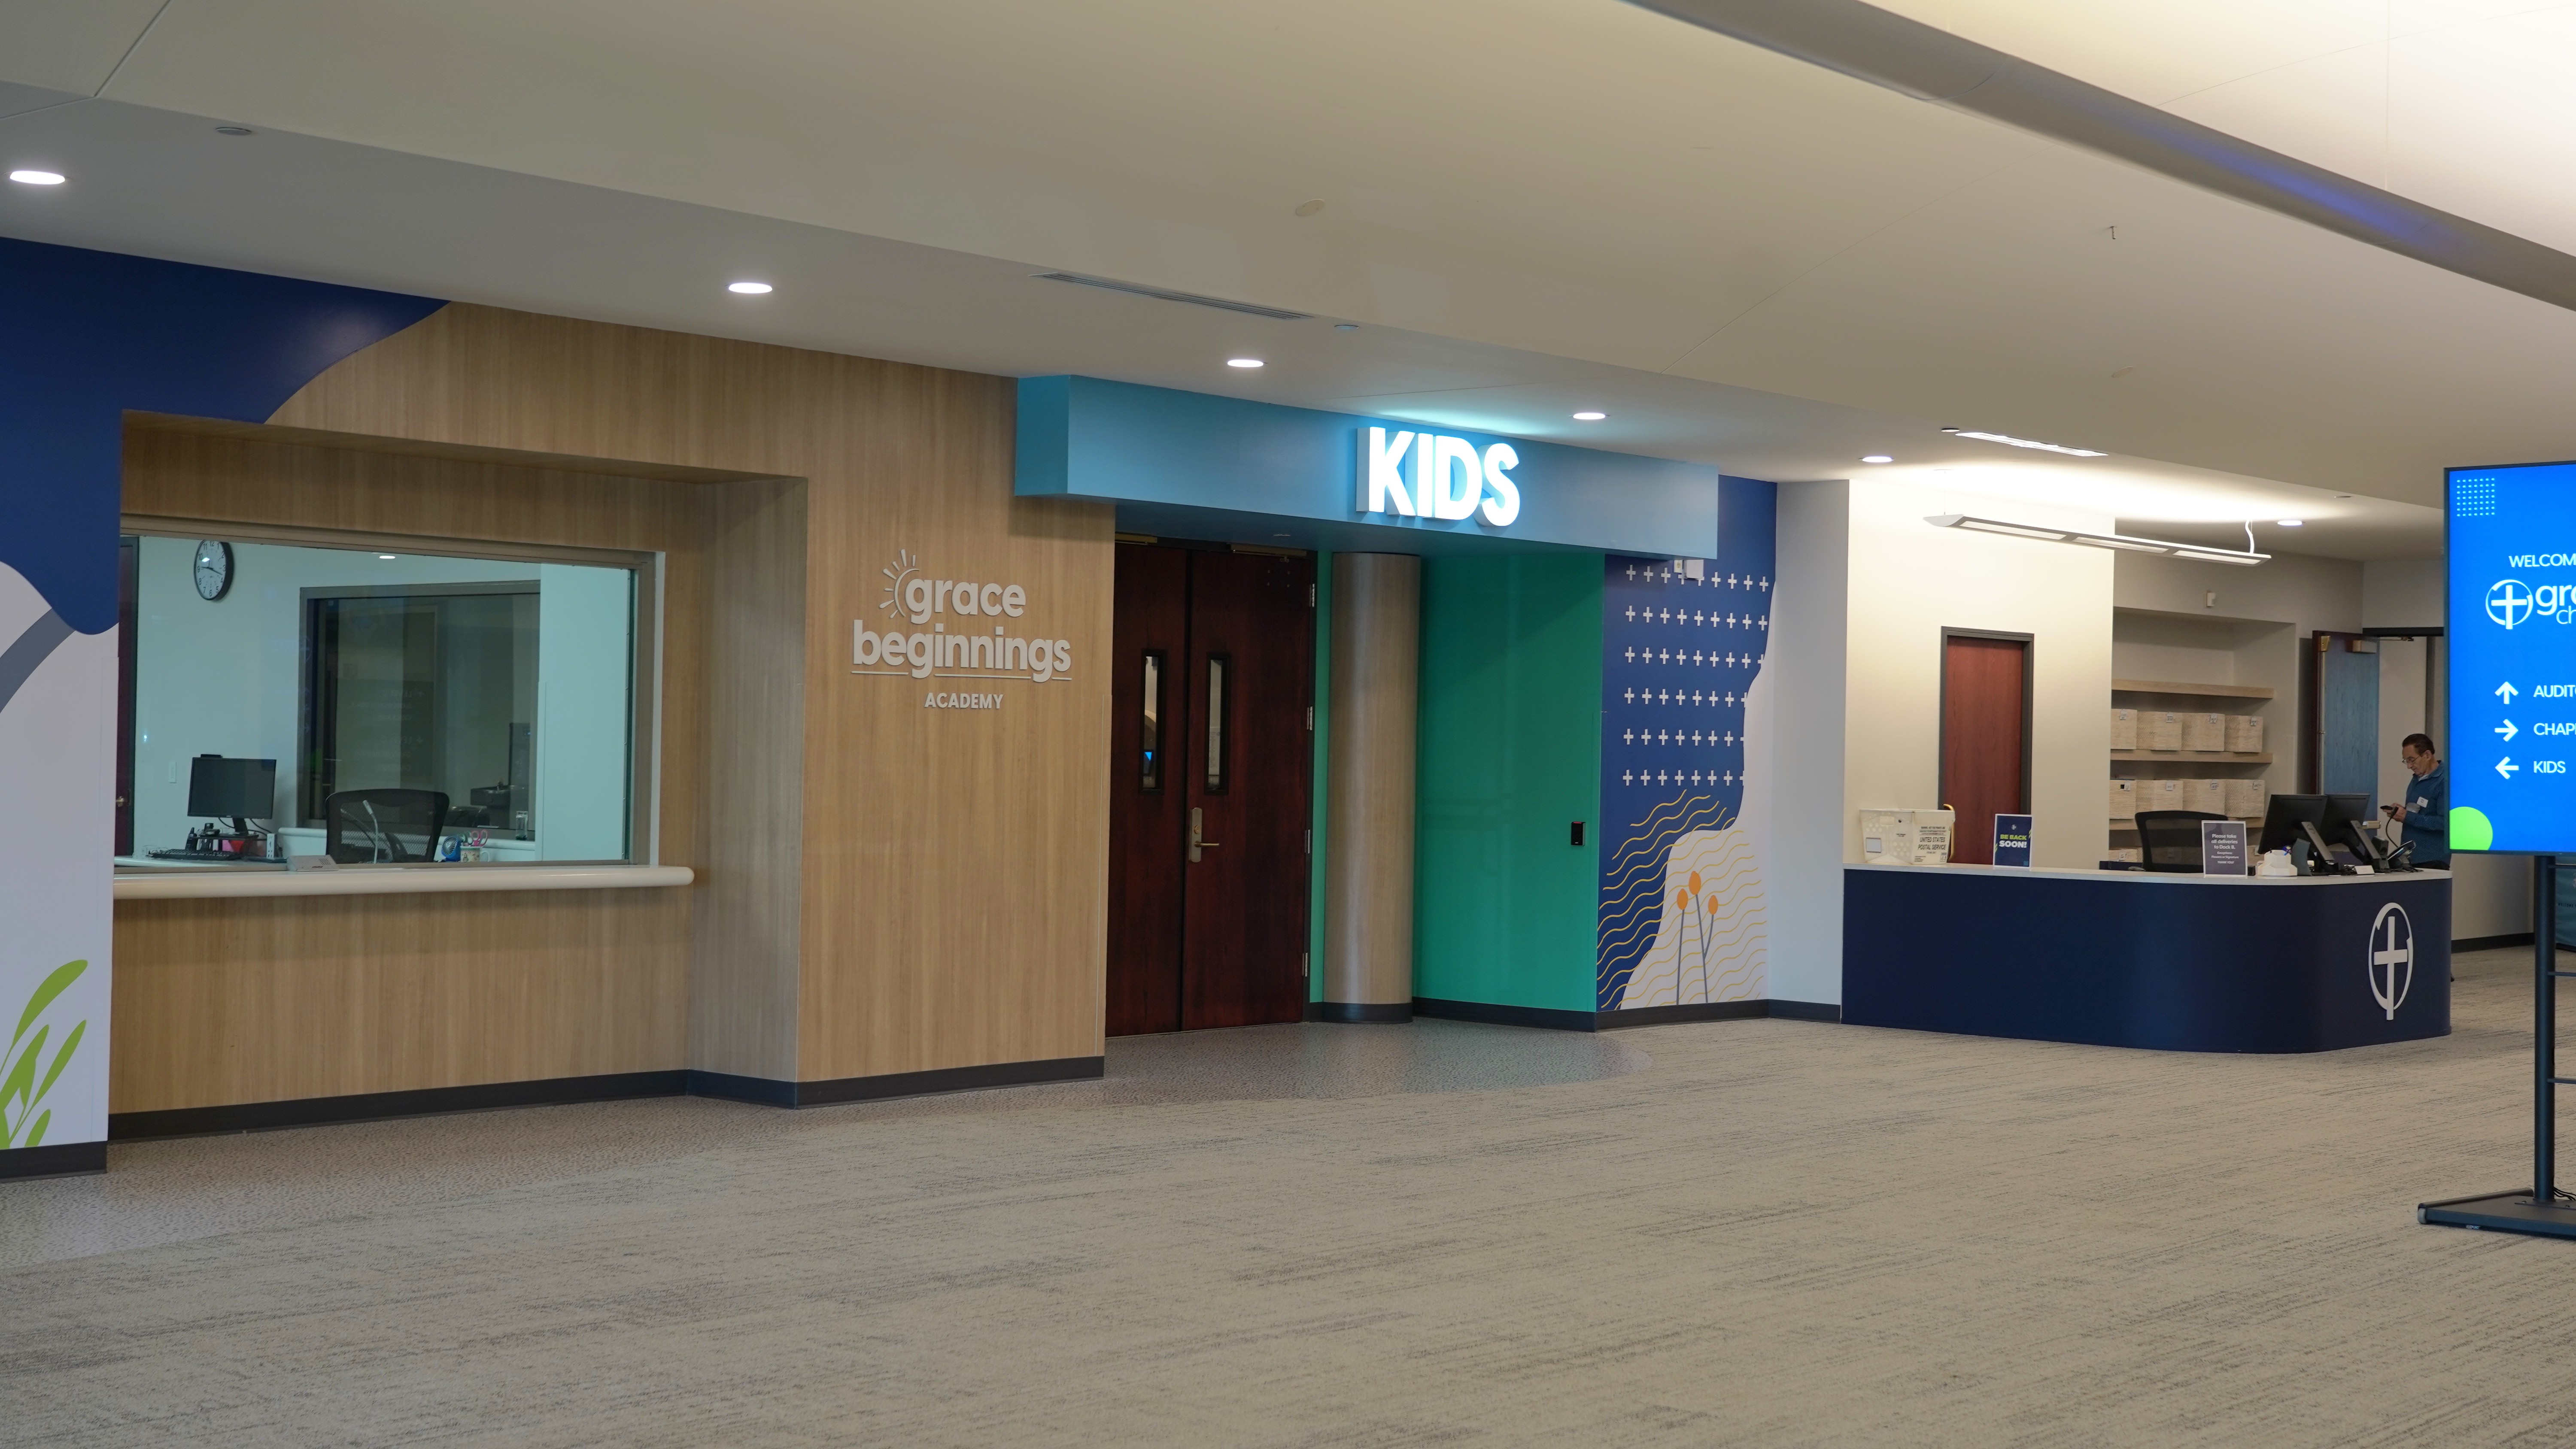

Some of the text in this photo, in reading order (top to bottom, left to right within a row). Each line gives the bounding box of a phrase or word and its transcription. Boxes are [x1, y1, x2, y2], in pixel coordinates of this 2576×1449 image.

[1357, 426, 1520, 527] KIDS
[222, 551, 224, 559] 2
[2508, 553, 2576, 567] WELCOM
[905, 577, 1027, 624] grace
[2535, 585, 2576, 615] gr
[853, 619, 1072, 683] beginnings
[2533, 685, 2576, 697] AUDIT
[924, 692, 1004, 709] ACADEMY
[2533, 723, 2576, 735] CHAP
[2533, 761, 2566, 773] KIDS
[1999, 840, 2027, 848] SOON!
